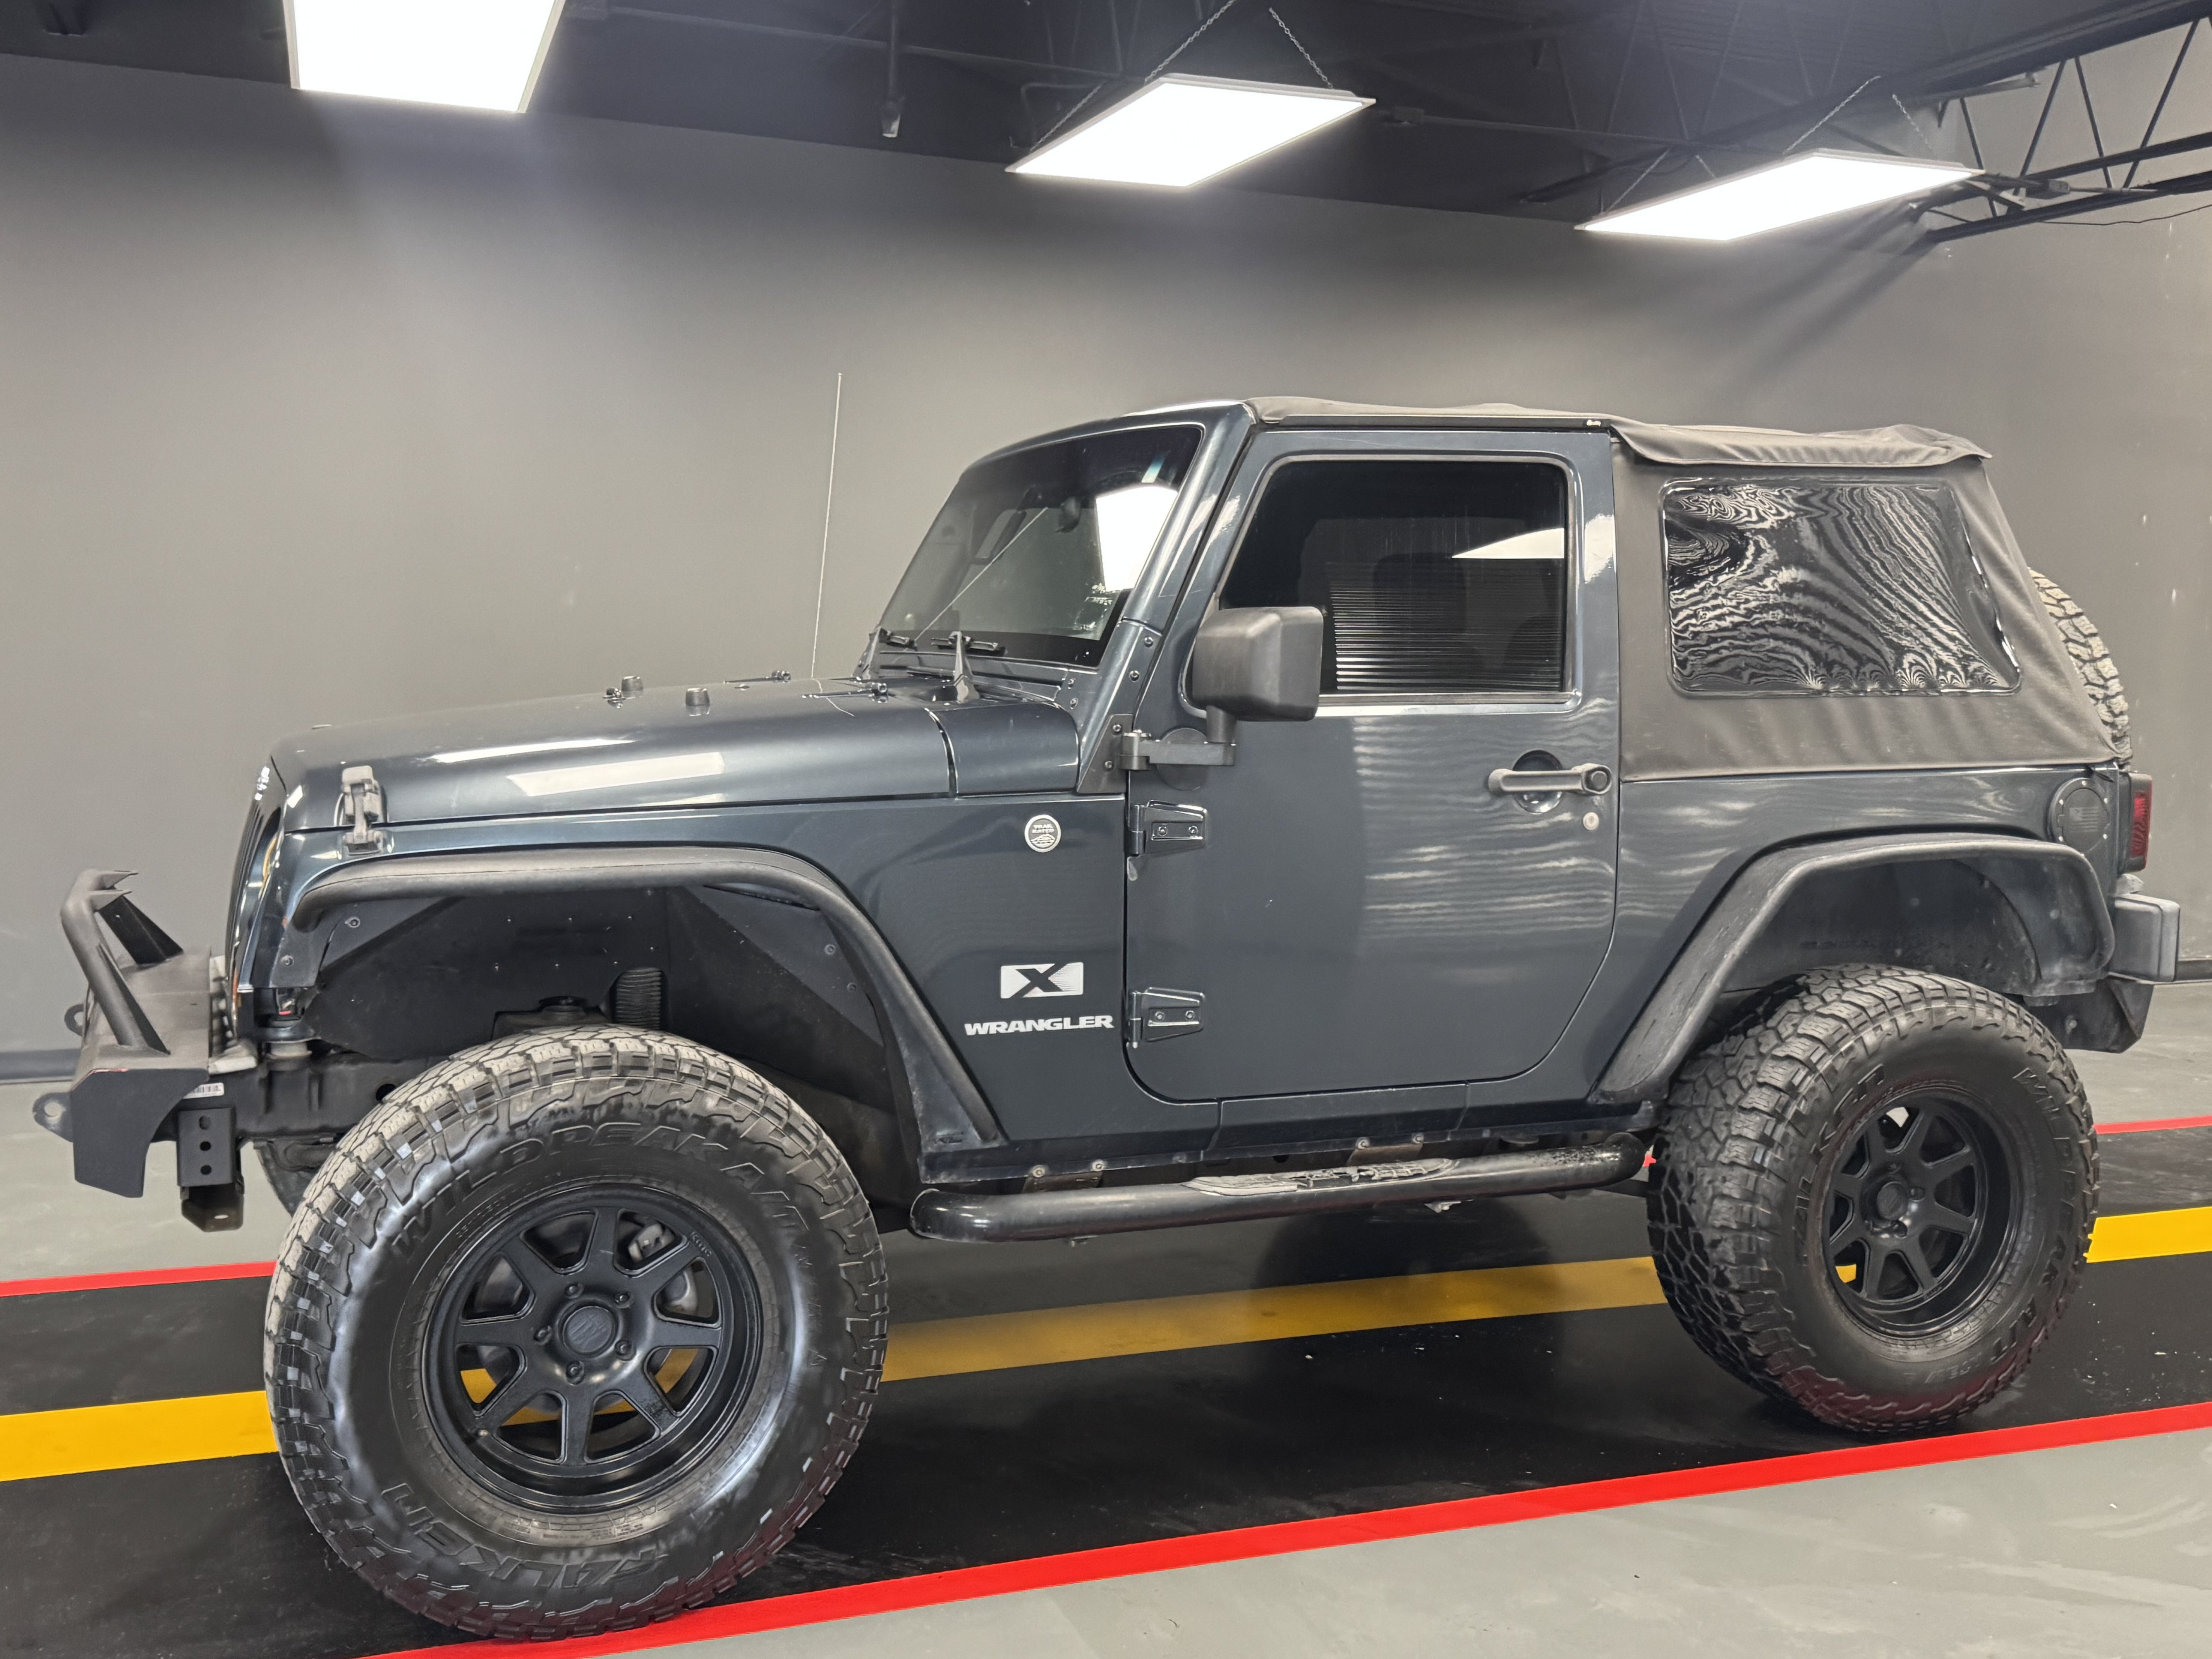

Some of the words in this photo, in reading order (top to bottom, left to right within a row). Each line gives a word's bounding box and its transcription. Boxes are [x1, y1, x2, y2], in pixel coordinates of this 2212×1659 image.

[964, 1015, 1115, 1036] WRANGLER
[1008, 962, 1070, 998] X
[389, 1121, 729, 1264] WILDPEAK
[2013, 1067, 2077, 1286] WILDPEAK
[381, 1482, 669, 1589] FALKEN
